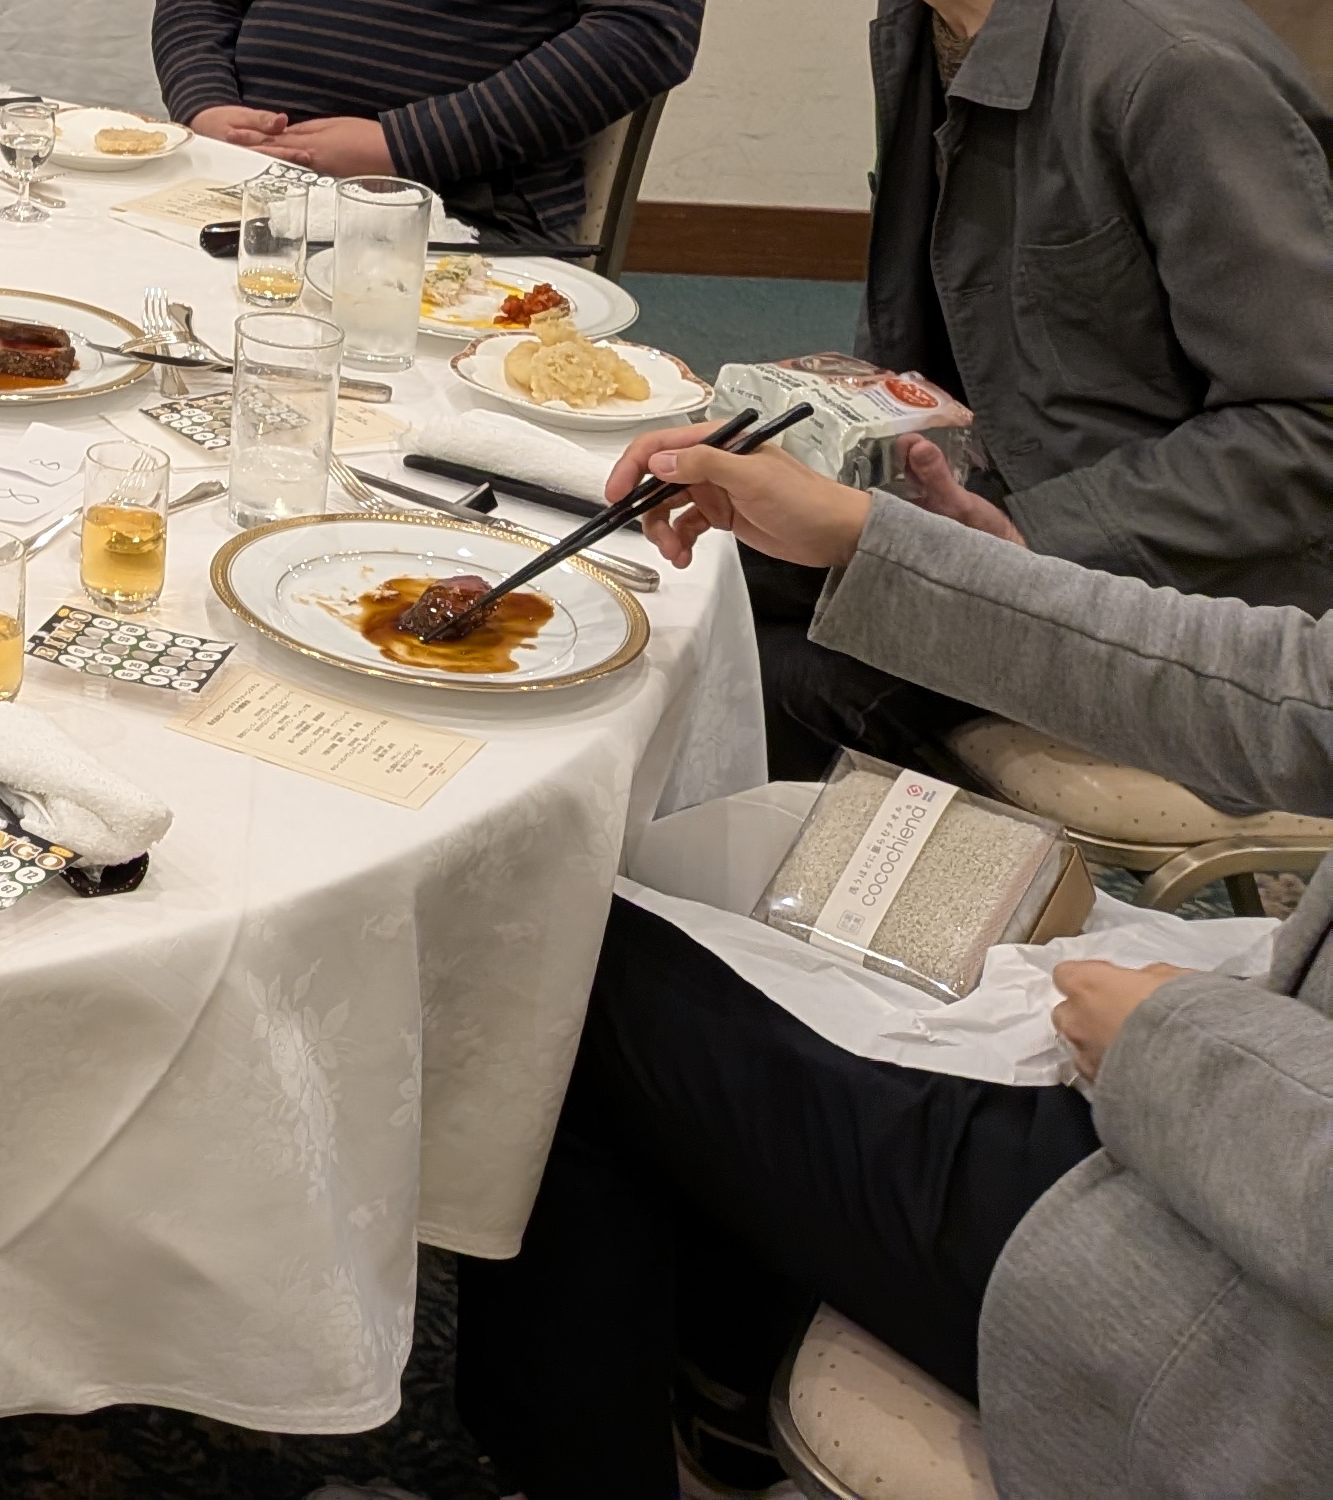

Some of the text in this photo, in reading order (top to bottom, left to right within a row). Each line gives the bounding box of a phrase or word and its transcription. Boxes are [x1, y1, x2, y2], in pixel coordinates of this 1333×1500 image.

[32, 609, 93, 662] BINGO
[0, 858, 40, 881] 60 72
[861, 806, 928, 908] cocochiena
[1, 884, 17, 895] 67
